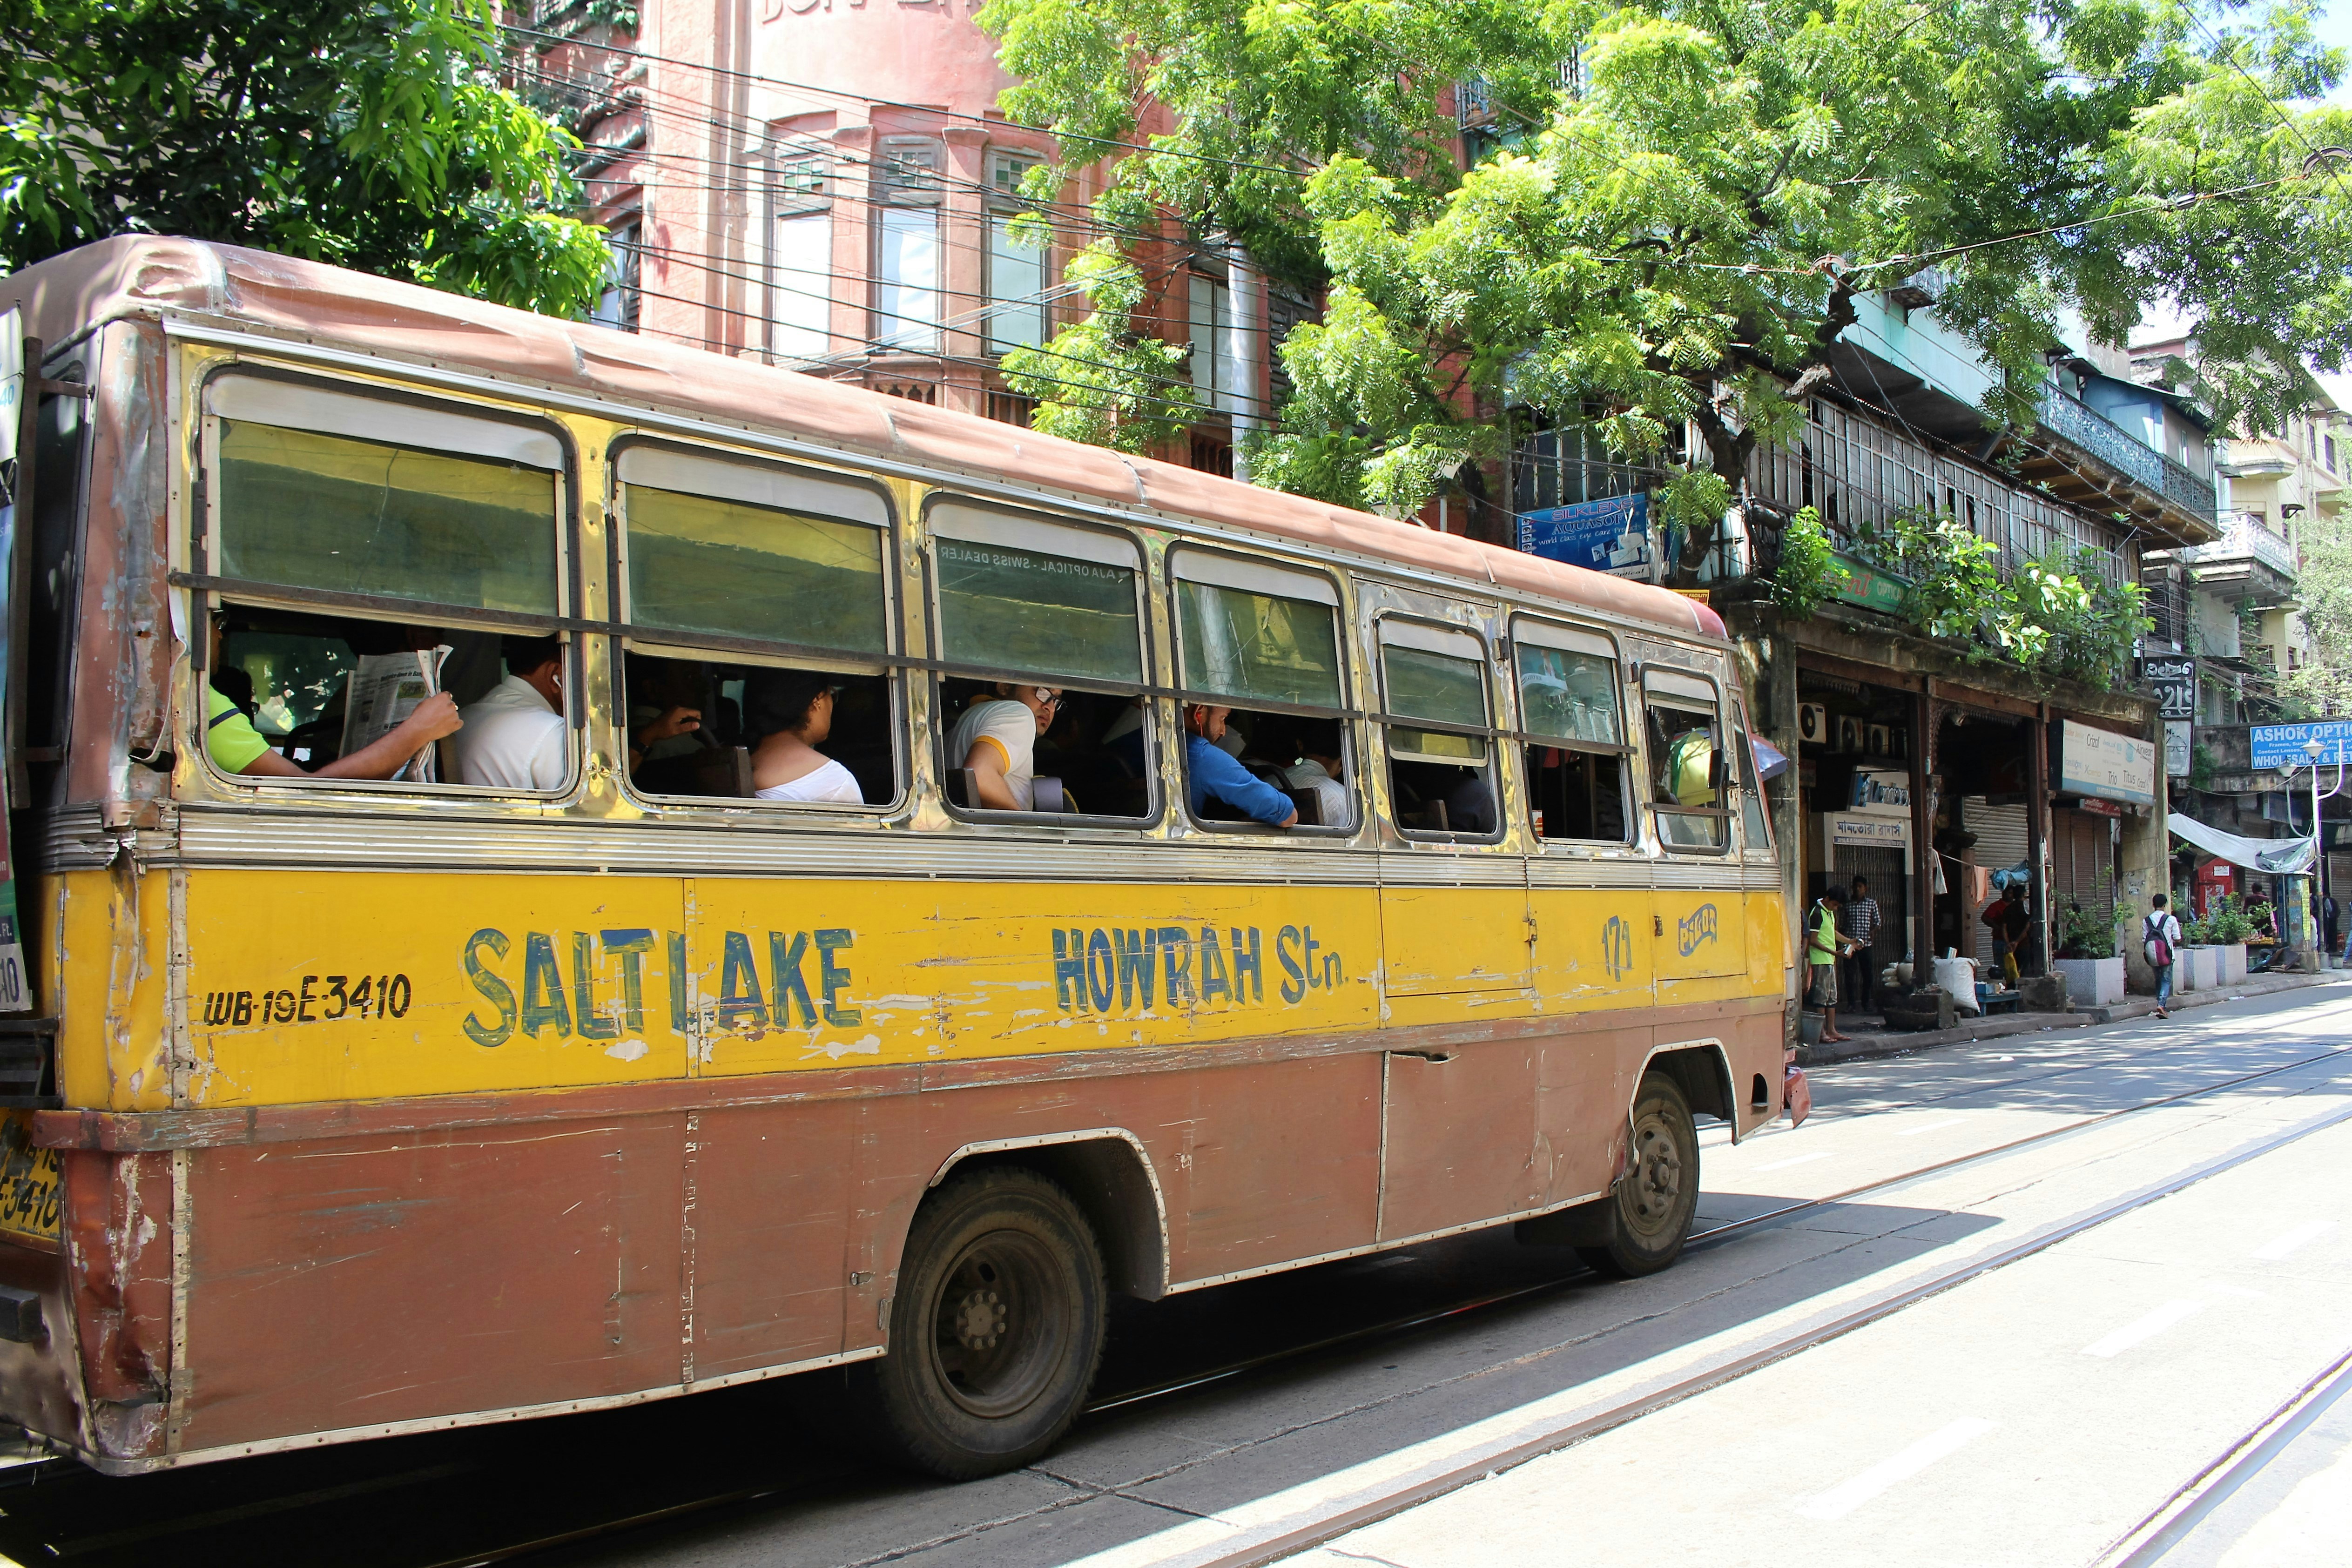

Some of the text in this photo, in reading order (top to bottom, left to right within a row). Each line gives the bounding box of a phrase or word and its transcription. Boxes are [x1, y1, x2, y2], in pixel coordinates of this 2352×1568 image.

[1551, 498, 1634, 522] SILKLENS
[1614, 524, 1641, 534] Procts
[2253, 726, 2308, 742] ASHOK
[2086, 733, 2100, 749] Crizal
[2136, 743, 2153, 757] Airwear
[2322, 752, 2330, 763] &
[2108, 770, 2117, 785] Trio
[2123, 770, 2136, 785] Titus
[1051, 924, 1349, 1014] HOWRAH Stn.
[463, 928, 864, 1047] SALT LAKE
